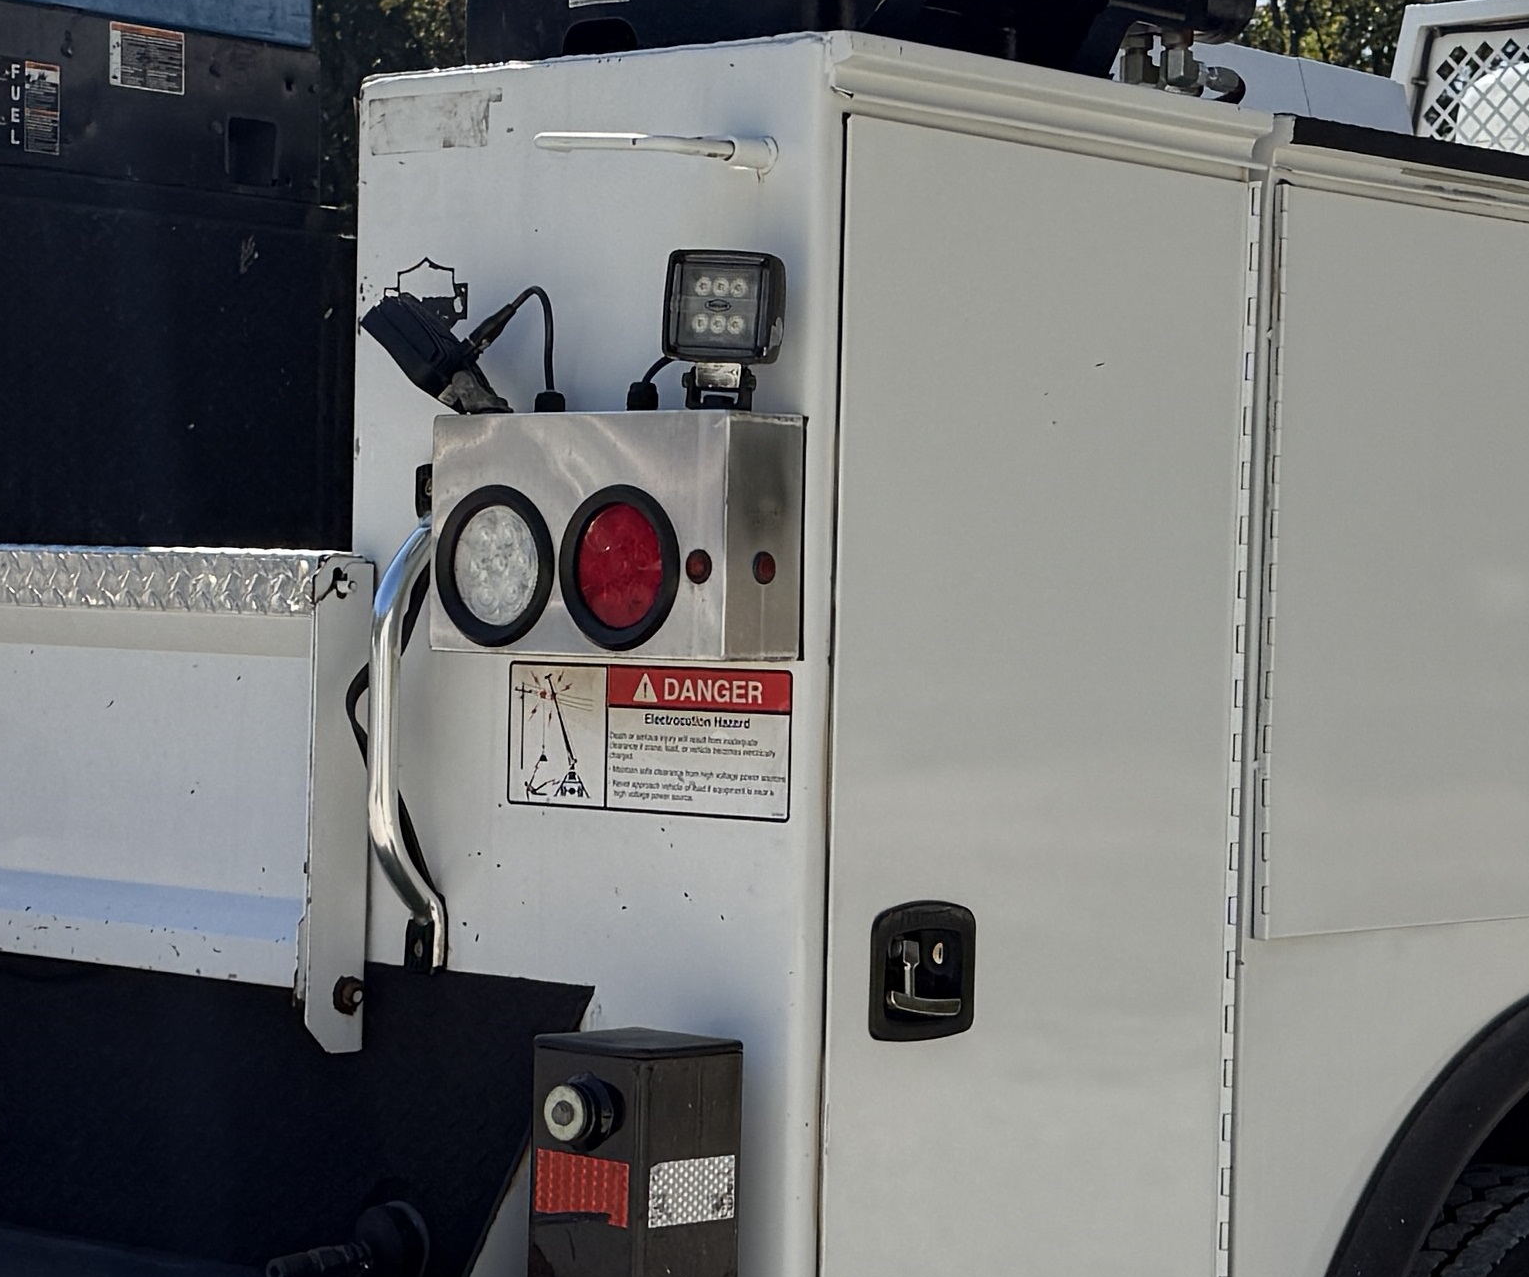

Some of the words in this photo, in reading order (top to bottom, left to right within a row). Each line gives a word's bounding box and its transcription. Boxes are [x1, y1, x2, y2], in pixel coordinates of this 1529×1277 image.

[663, 677, 763, 705] DANGER
[644, 712, 711, 728] Electrocution
[714, 716, 751, 729] Hazard
